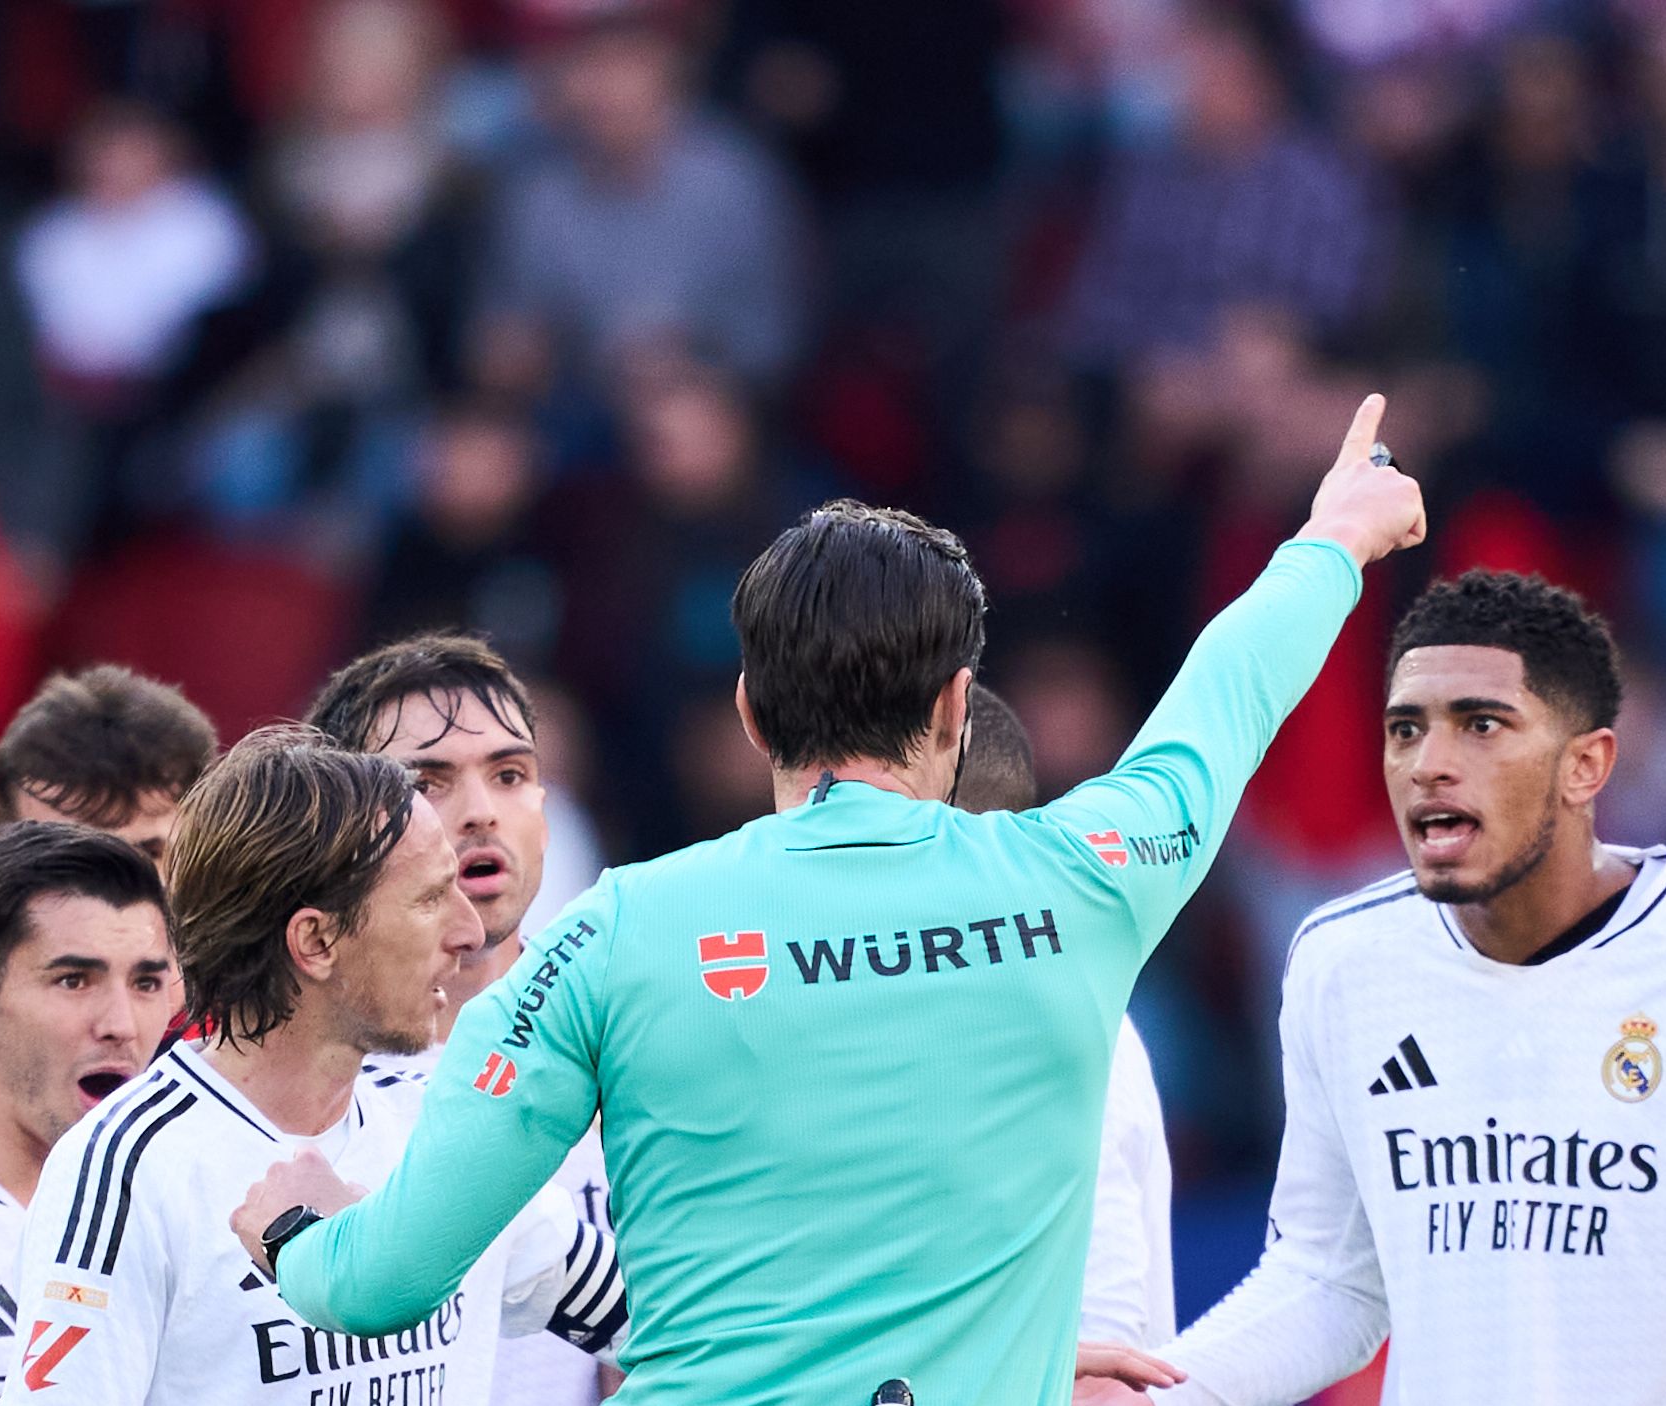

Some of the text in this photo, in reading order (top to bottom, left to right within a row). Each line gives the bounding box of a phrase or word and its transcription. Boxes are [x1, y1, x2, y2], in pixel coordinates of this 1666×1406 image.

[502, 920, 597, 1049] WÜRTH
[787, 909, 1063, 985] WÜRTH
[1383, 1117, 1659, 1193] Emirates
[1428, 1199, 1609, 1256] FLY BETTER
